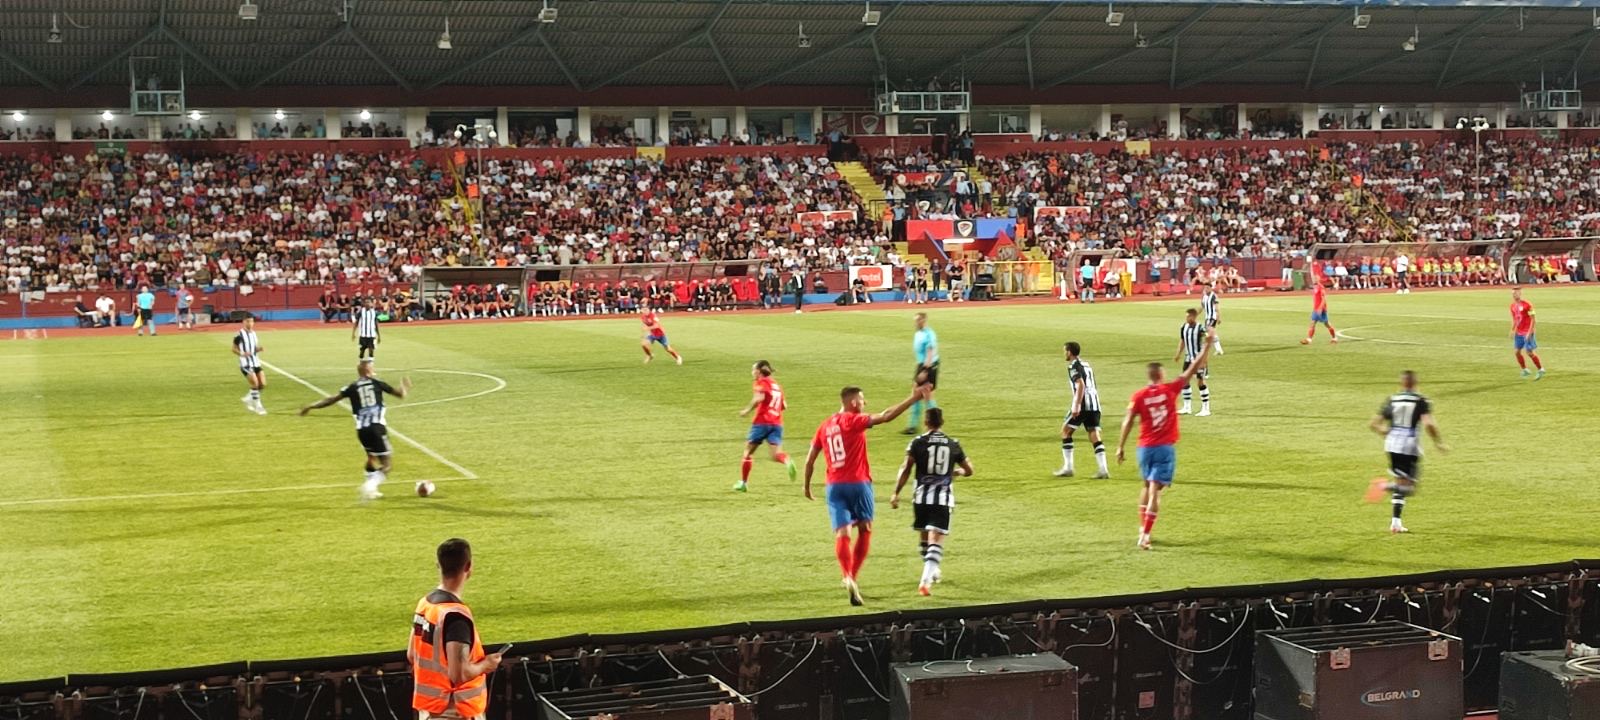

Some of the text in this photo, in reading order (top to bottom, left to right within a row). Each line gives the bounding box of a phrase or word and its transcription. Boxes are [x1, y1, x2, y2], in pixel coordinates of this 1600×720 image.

[357, 385, 377, 408] 15
[827, 433, 847, 462] 19
[927, 445, 951, 476] 19
[1367, 689, 1421, 703] BELGRAND
